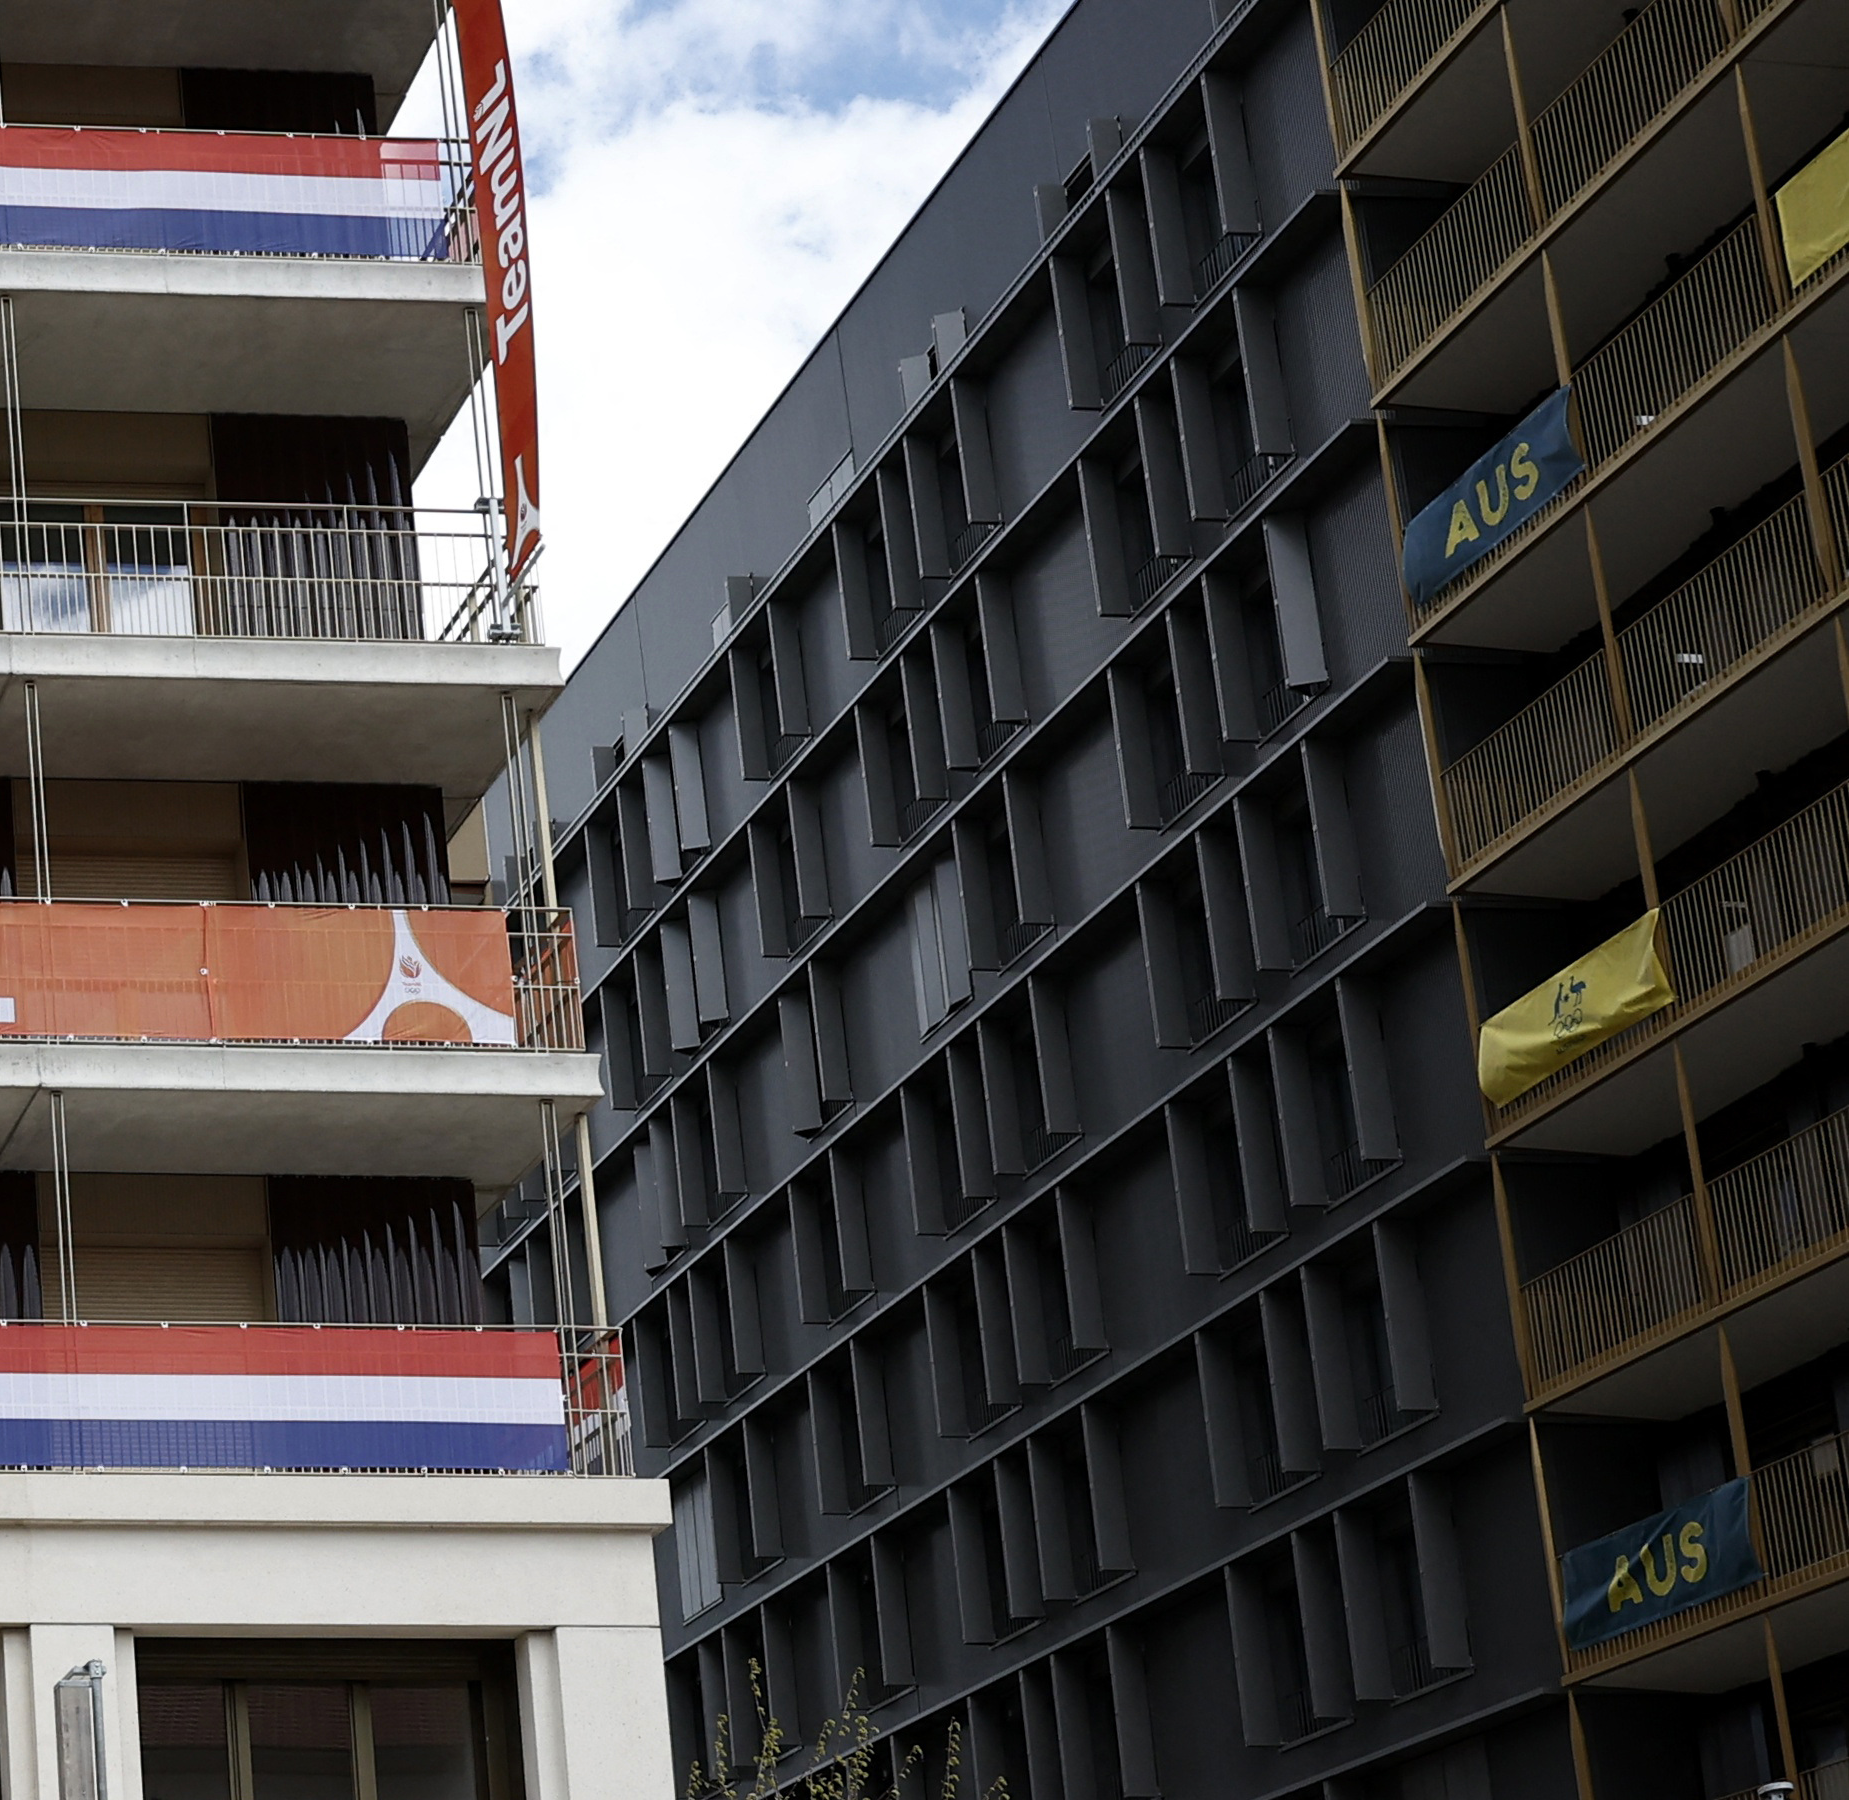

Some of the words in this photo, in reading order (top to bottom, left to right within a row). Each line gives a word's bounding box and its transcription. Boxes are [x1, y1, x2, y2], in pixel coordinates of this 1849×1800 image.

[473, 59, 529, 366] TeamNL
[1445, 442, 1539, 559] AUS
[1607, 1521, 1708, 1613] AUS
